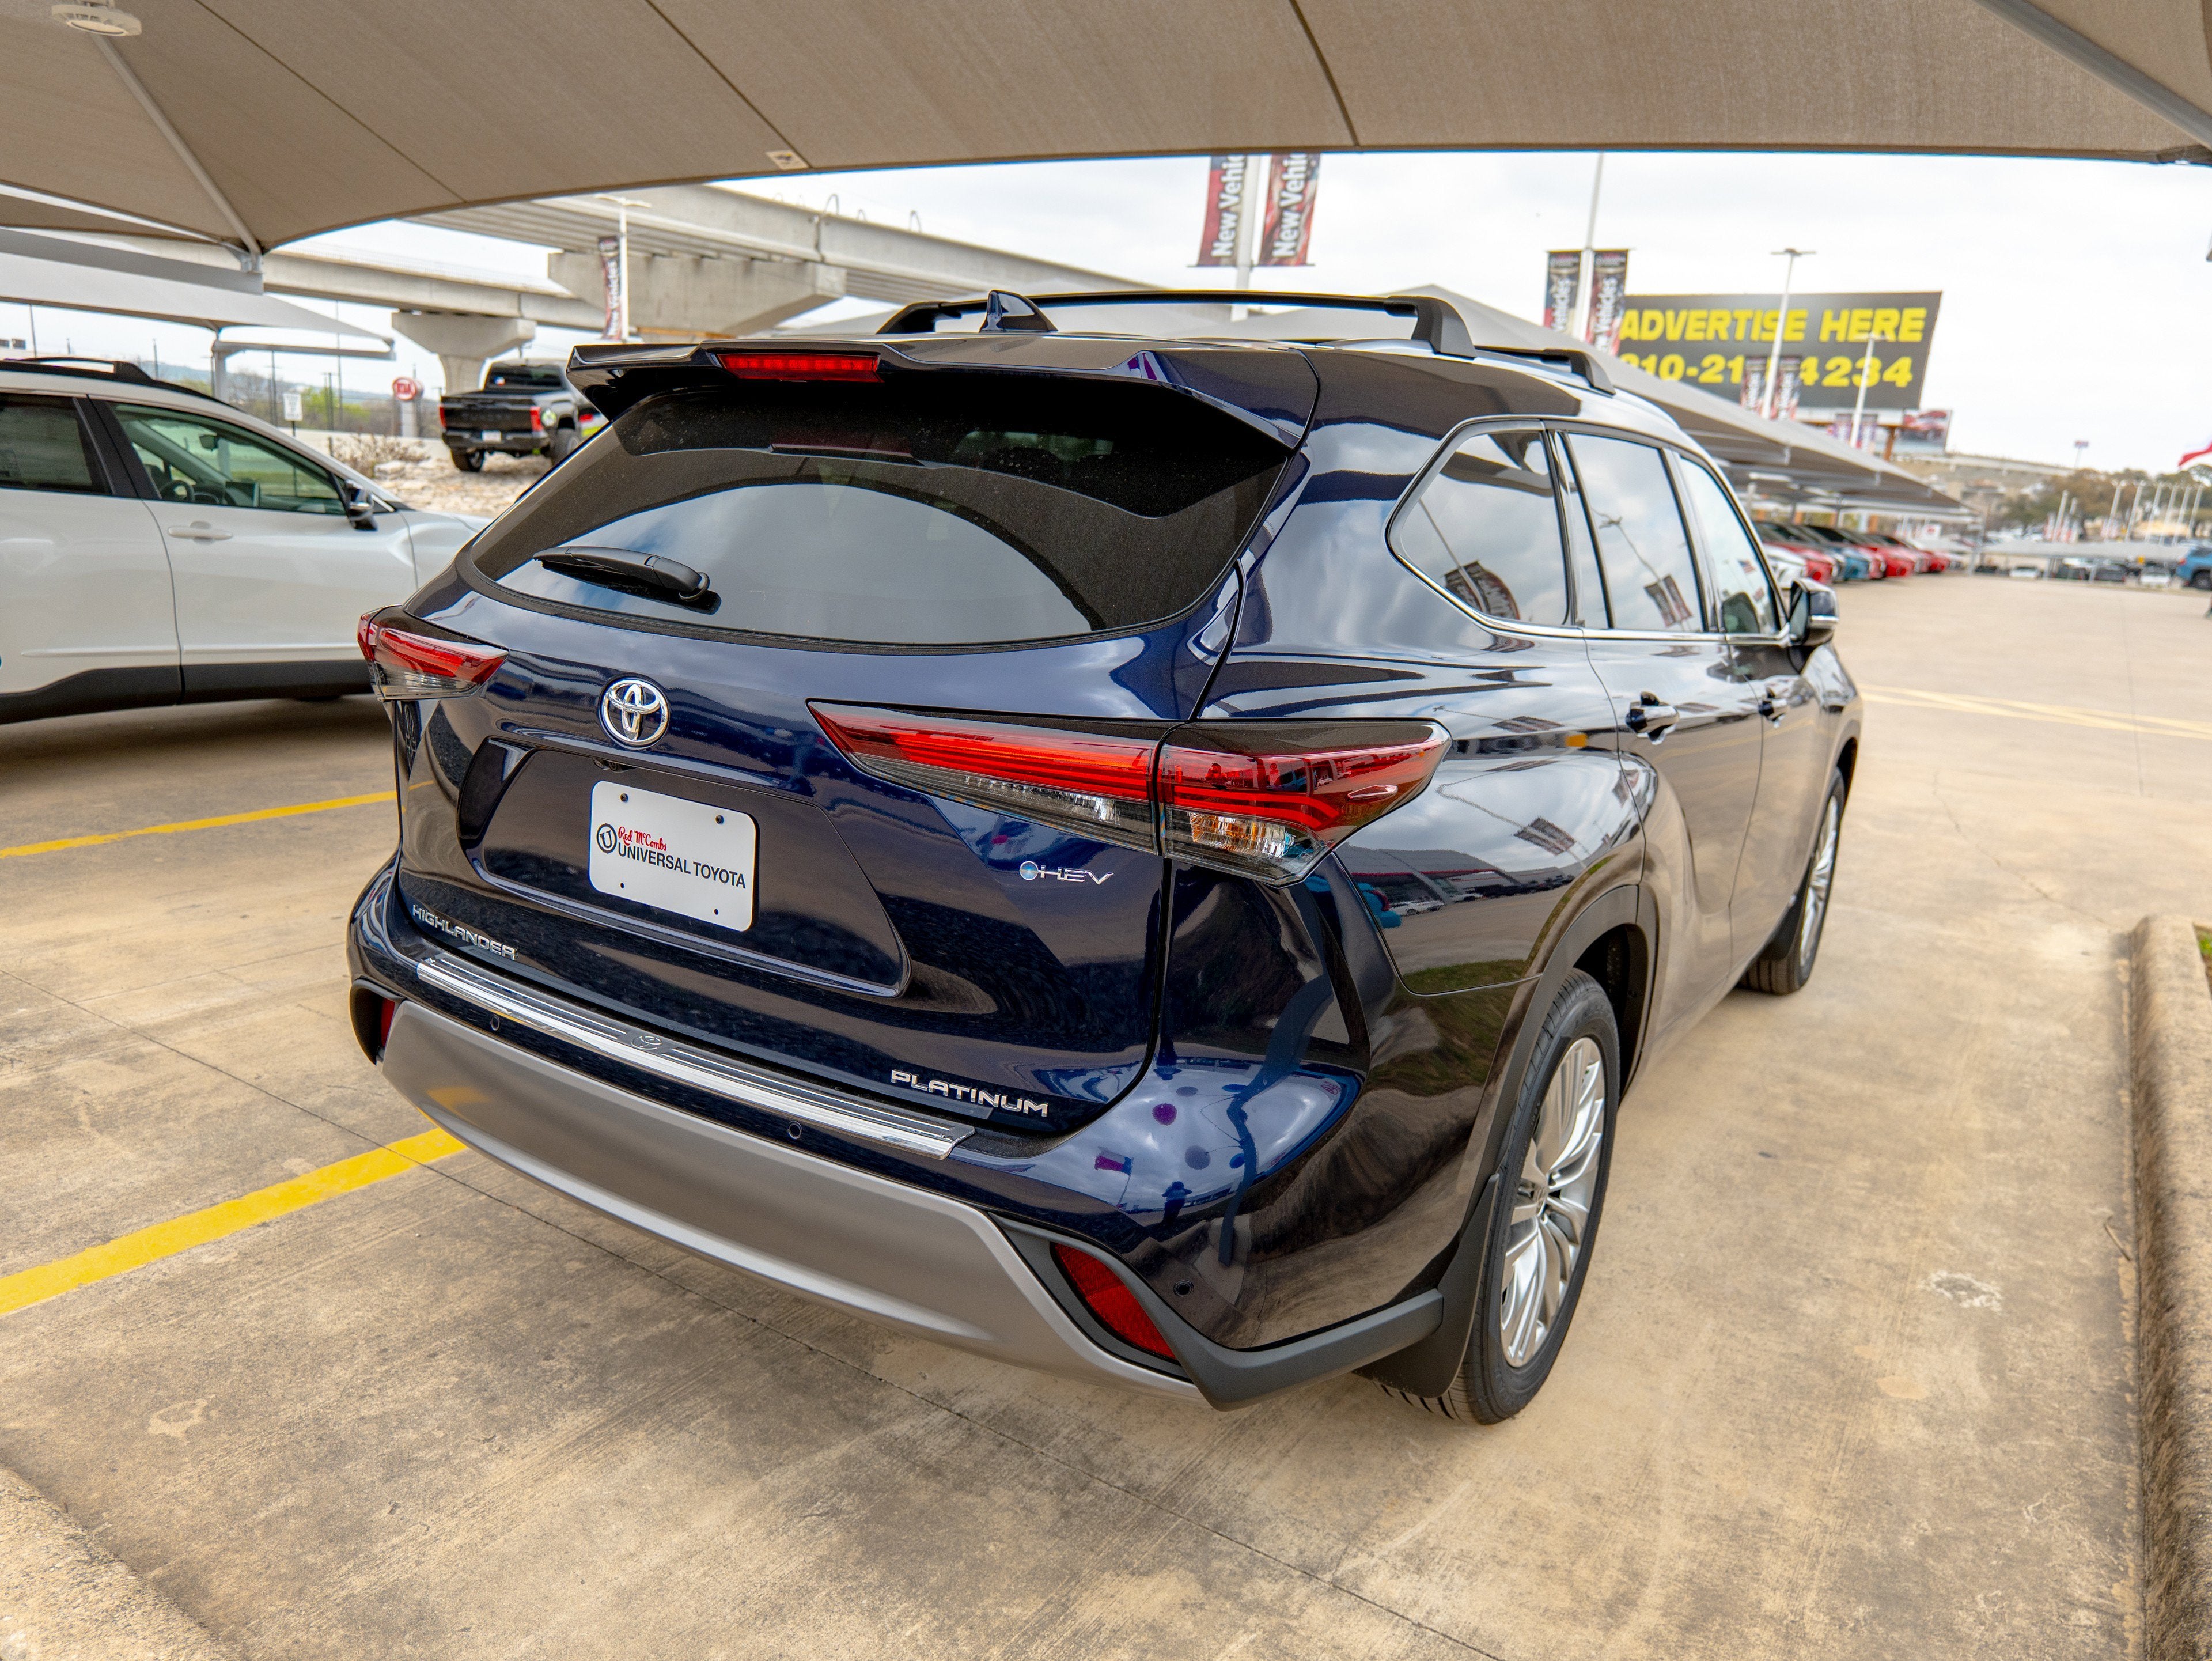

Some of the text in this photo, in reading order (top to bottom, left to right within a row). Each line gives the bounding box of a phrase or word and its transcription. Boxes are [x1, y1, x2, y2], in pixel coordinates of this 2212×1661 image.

[1211, 213, 1239, 257] New
[1272, 211, 1302, 257] New
[1594, 277, 1618, 334] Vehicles
[1619, 307, 1927, 342] ADVERTISE HERE
[618, 826, 666, 852] Red McCombs
[618, 842, 746, 889] UNIVERSAL TOYOTA
[1040, 865, 1115, 885] HEV
[412, 904, 516, 961] HIGHLANDER
[891, 1069, 1049, 1118] PLATINUM
